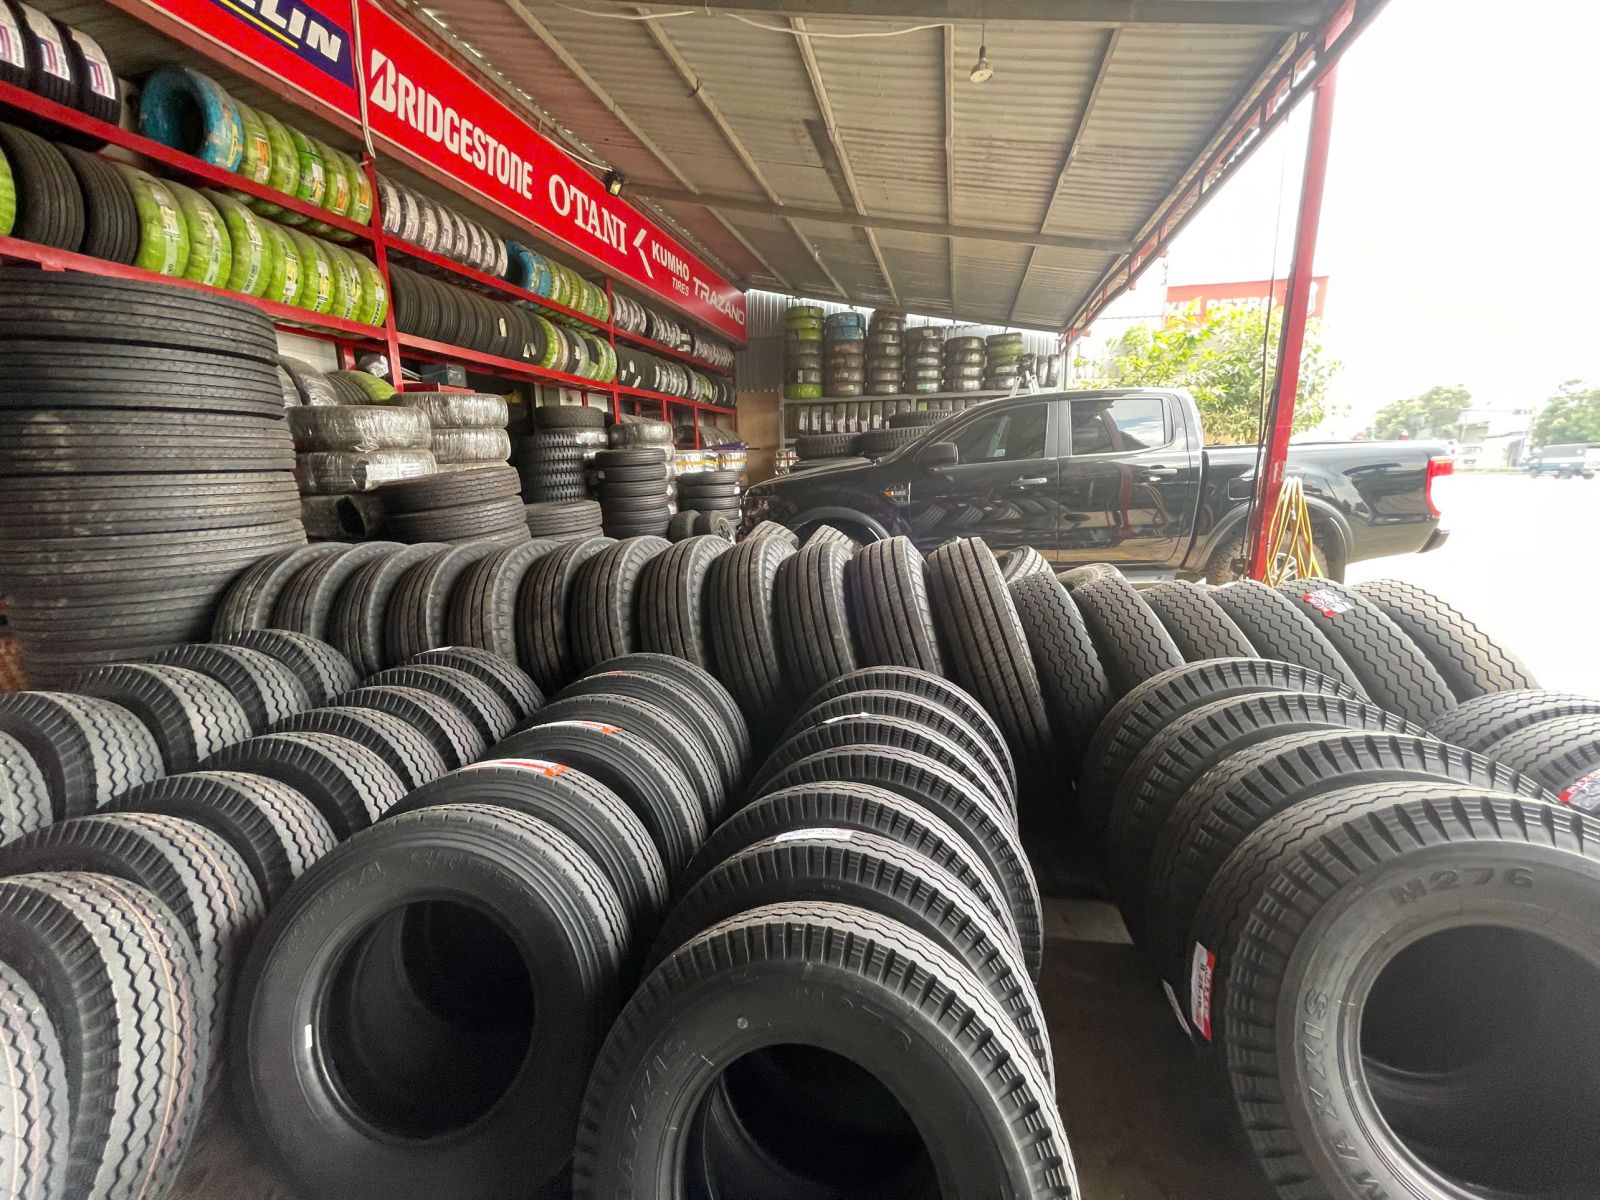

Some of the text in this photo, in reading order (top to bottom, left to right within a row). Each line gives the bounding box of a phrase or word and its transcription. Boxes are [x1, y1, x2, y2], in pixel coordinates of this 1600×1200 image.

[239, 0, 342, 62] LIN
[369, 49, 533, 200] BRIDGESTONE
[548, 174, 628, 255] OTANI
[652, 239, 690, 281] KUMHO
[672, 276, 690, 296] TIRES
[692, 276, 745, 325] TRAZANO
[1388, 866, 1534, 906] M276
